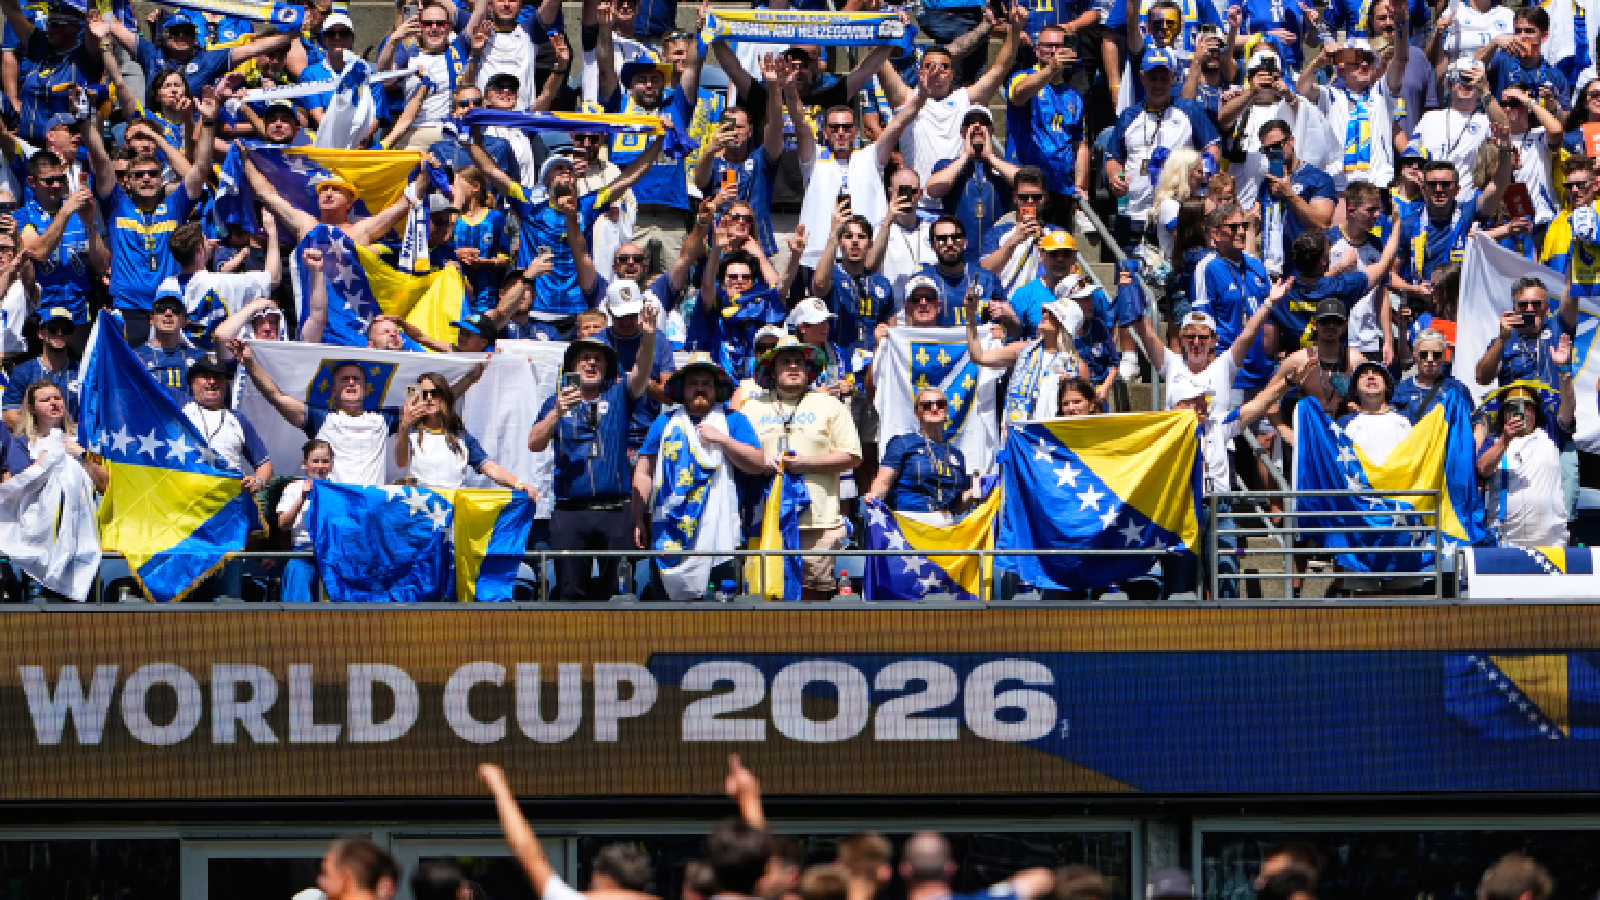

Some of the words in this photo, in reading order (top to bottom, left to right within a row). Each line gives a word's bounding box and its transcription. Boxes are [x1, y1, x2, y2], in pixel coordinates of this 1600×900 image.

[17, 662, 420, 746] WORLD
[442, 660, 659, 744] CUP
[680, 658, 1058, 744] 2026
